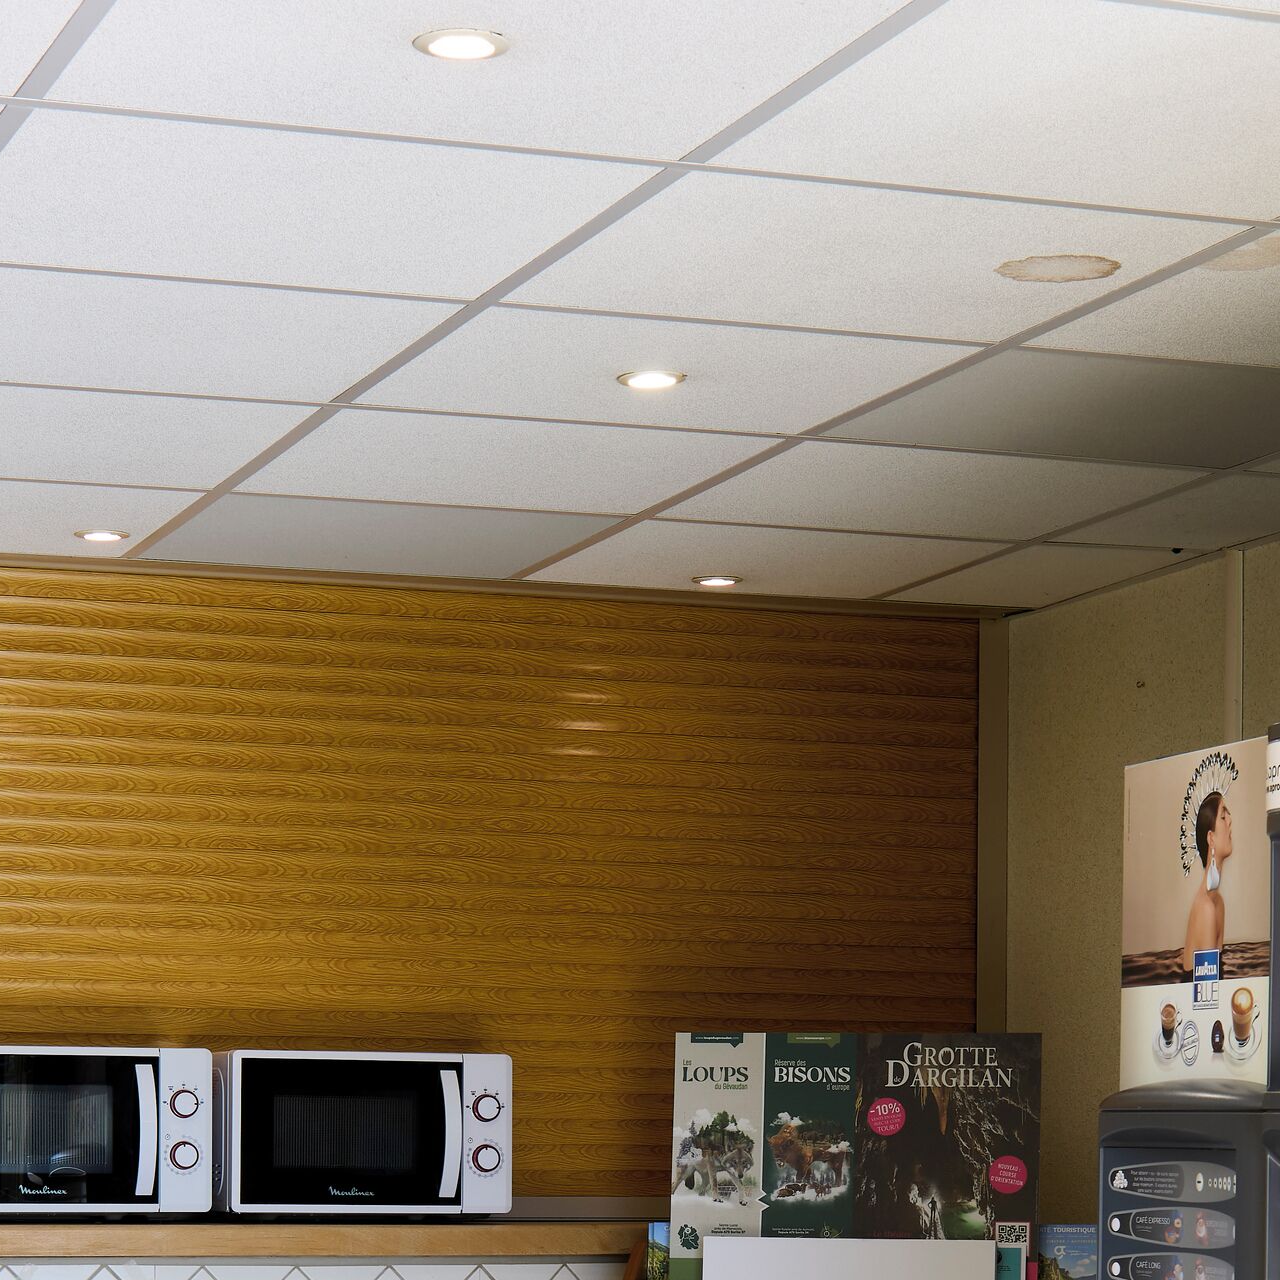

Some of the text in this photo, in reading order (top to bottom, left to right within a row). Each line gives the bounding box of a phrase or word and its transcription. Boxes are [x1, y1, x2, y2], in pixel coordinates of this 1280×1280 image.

[1194, 981, 1219, 1003] BLUE
[903, 1042, 999, 1067] GROTTE
[774, 1058, 807, 1067] Réserve des
[682, 1066, 749, 1083] LOUPS
[774, 1067, 851, 1083] BISONS
[885, 1060, 1013, 1088] DARGILAN
[893, 1075, 901, 1083] de
[722, 1082, 748, 1090] Gévaudan
[826, 1083, 850, 1091] d'europe
[999, 1170, 1017, 1178] COURSE
[991, 1176, 1024, 1186] D'ORIENTATION
[19, 1184, 67, 1194] Moulinex
[328, 1186, 375, 1196] Moulinex
[1136, 1216, 1171, 1226] CAFÉ EXPRESSO
[1136, 1261, 1161, 1270] CAFÉ LONG
